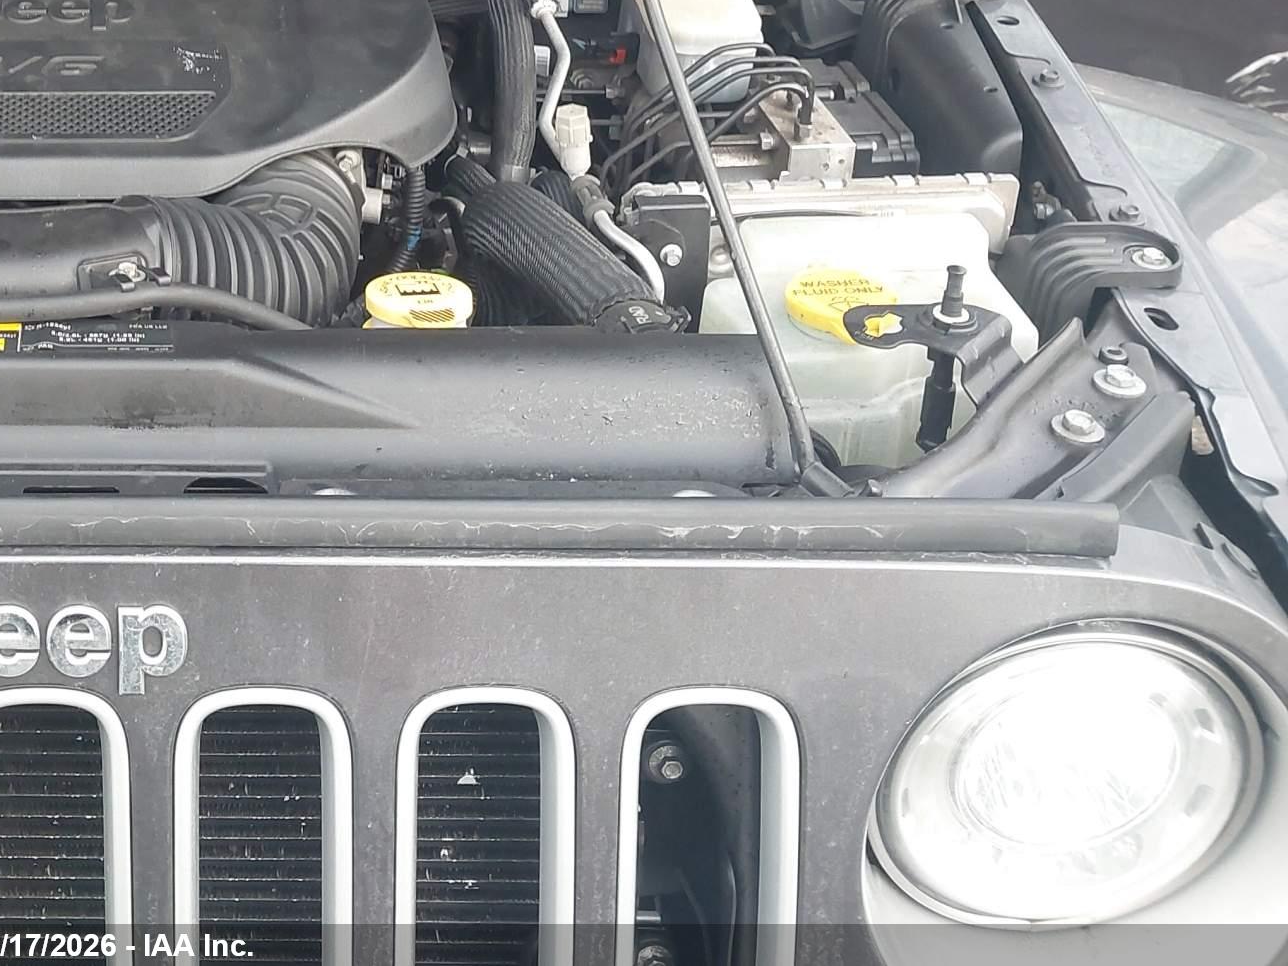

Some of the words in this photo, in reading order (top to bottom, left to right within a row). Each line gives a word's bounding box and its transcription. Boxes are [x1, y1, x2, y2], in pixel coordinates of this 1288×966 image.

[799, 278, 870, 288] WASHER
[792, 288, 839, 296] FLUID
[844, 286, 883, 294] ONLY
